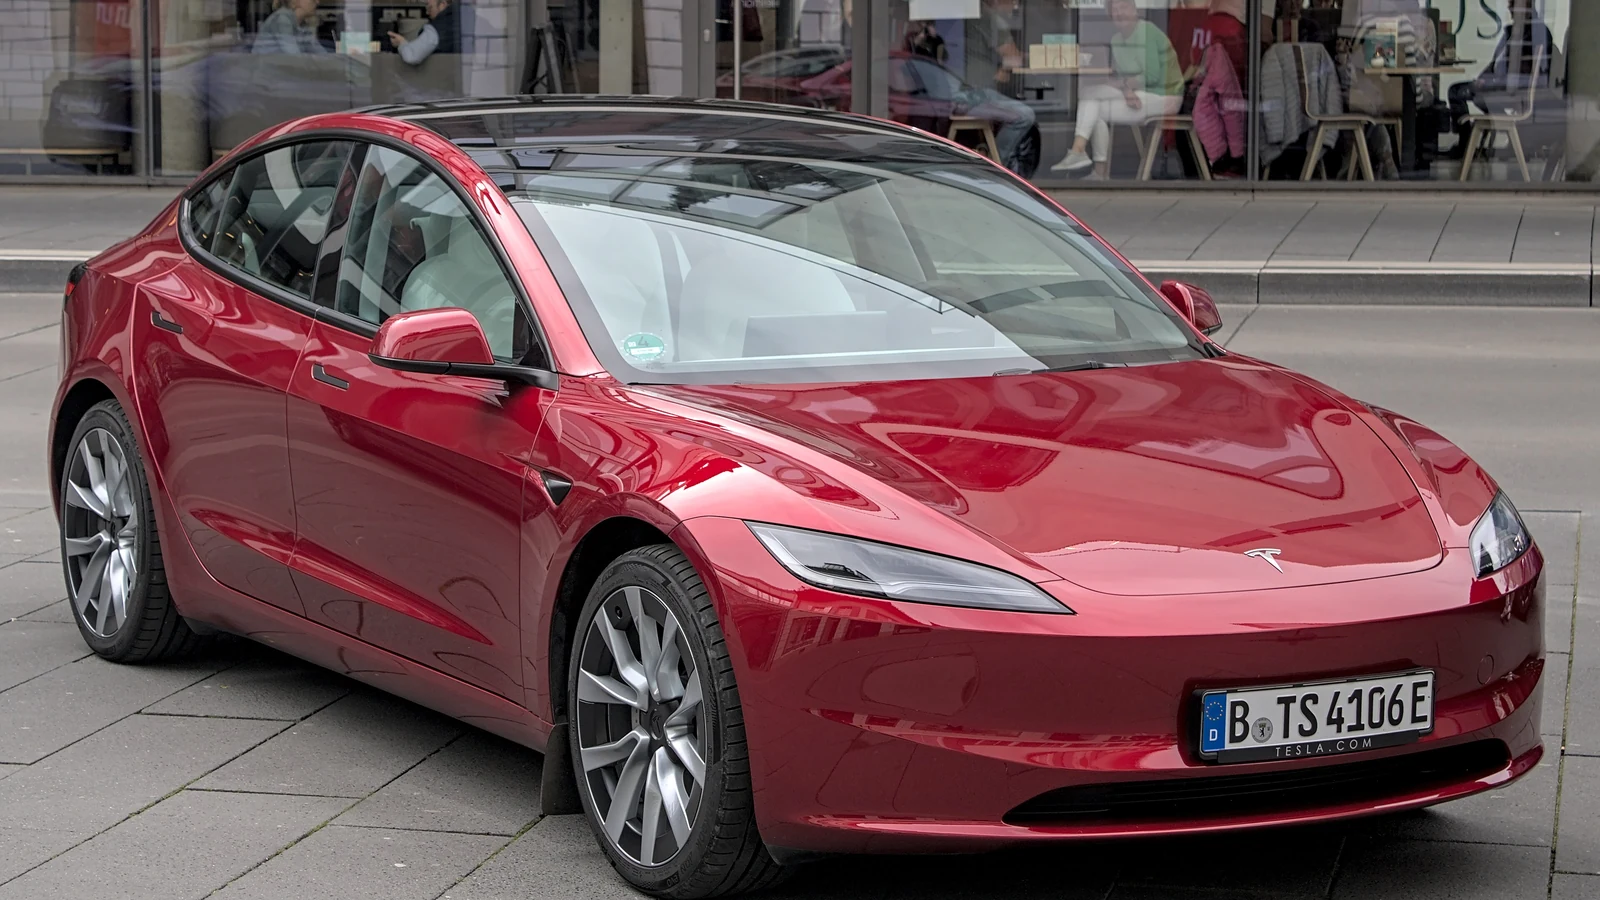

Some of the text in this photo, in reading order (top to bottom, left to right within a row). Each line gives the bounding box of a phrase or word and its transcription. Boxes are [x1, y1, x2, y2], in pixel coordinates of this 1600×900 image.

[1229, 700, 1250, 744] B
[1277, 693, 1319, 739] TS
[1209, 728, 1218, 742] D
[1275, 738, 1373, 757] TESLA.COM
